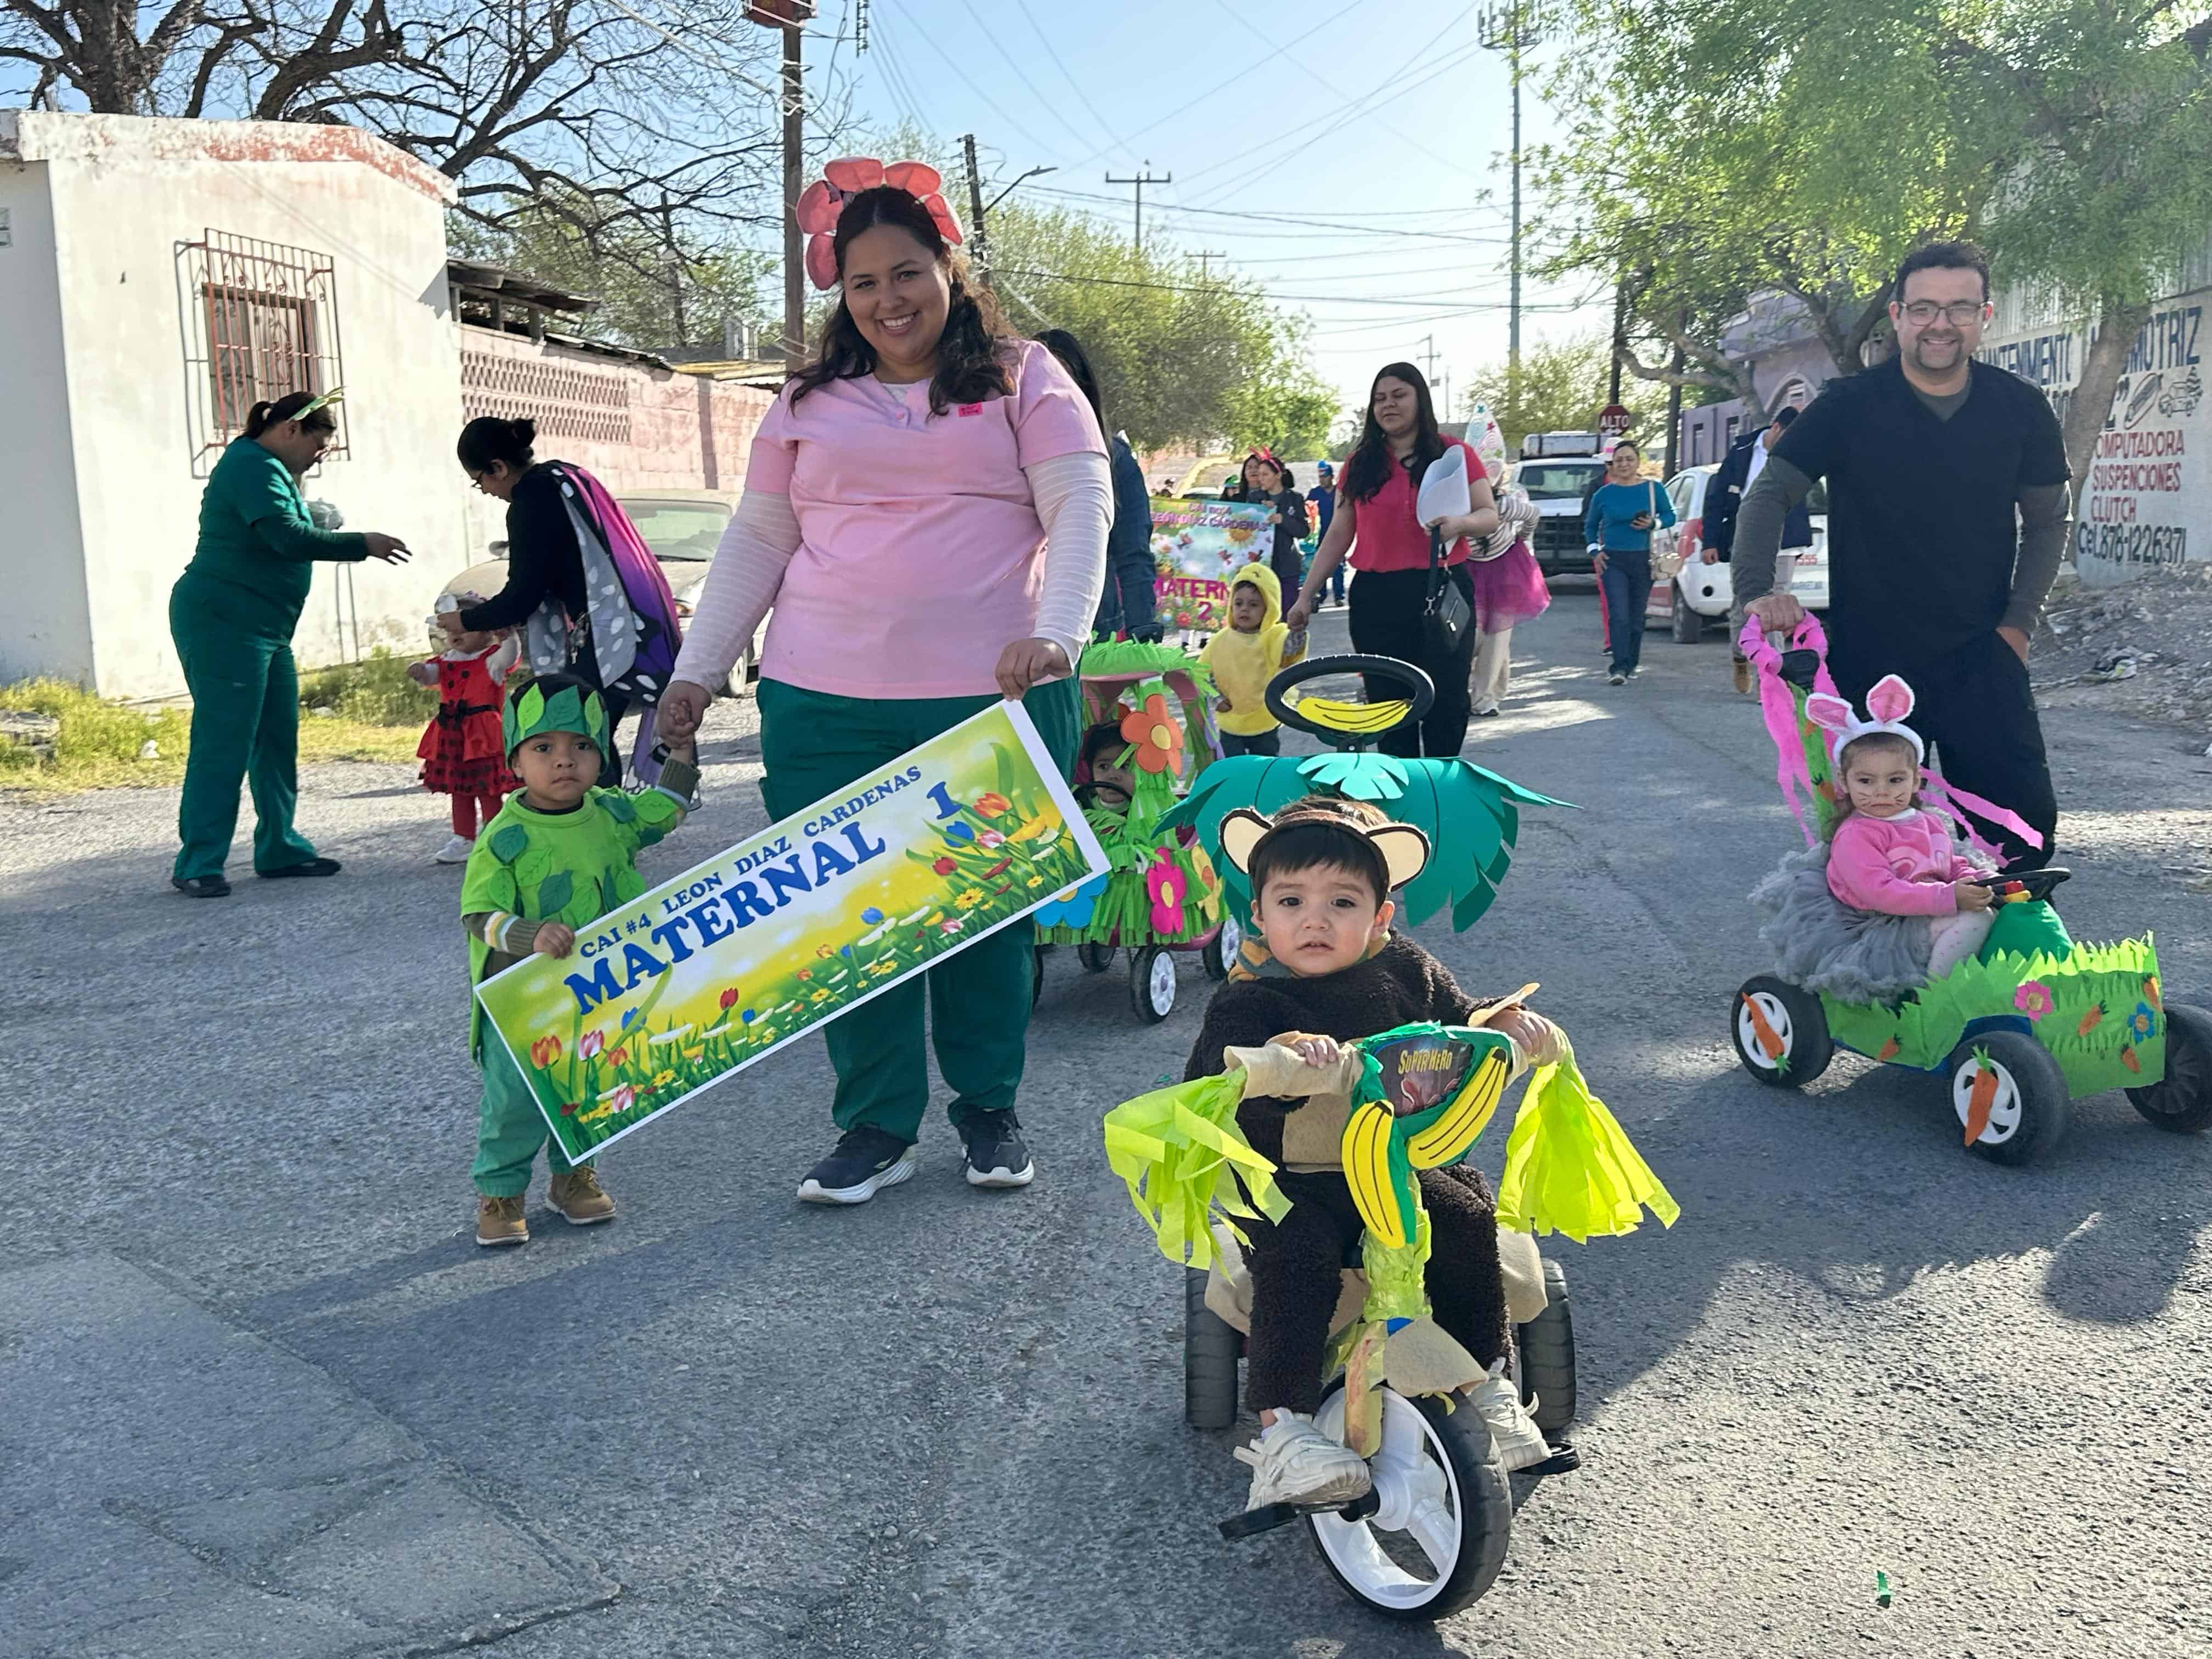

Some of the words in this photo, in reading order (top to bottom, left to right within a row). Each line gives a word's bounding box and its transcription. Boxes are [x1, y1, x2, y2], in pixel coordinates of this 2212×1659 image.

[1600, 415, 1629, 427] ALTO
[2092, 462, 2182, 492] SUSPENCIONES
[2091, 495, 2136, 522] CLUTCH
[1197, 601, 1212, 620] 2
[580, 927, 623, 957] CAI
[625, 913, 652, 935] #4
[662, 872, 723, 914] LEON
[734, 836, 792, 876] DIAZ
[804, 765, 922, 837] CARDENAS
[563, 821, 885, 1015] MATERNAL
